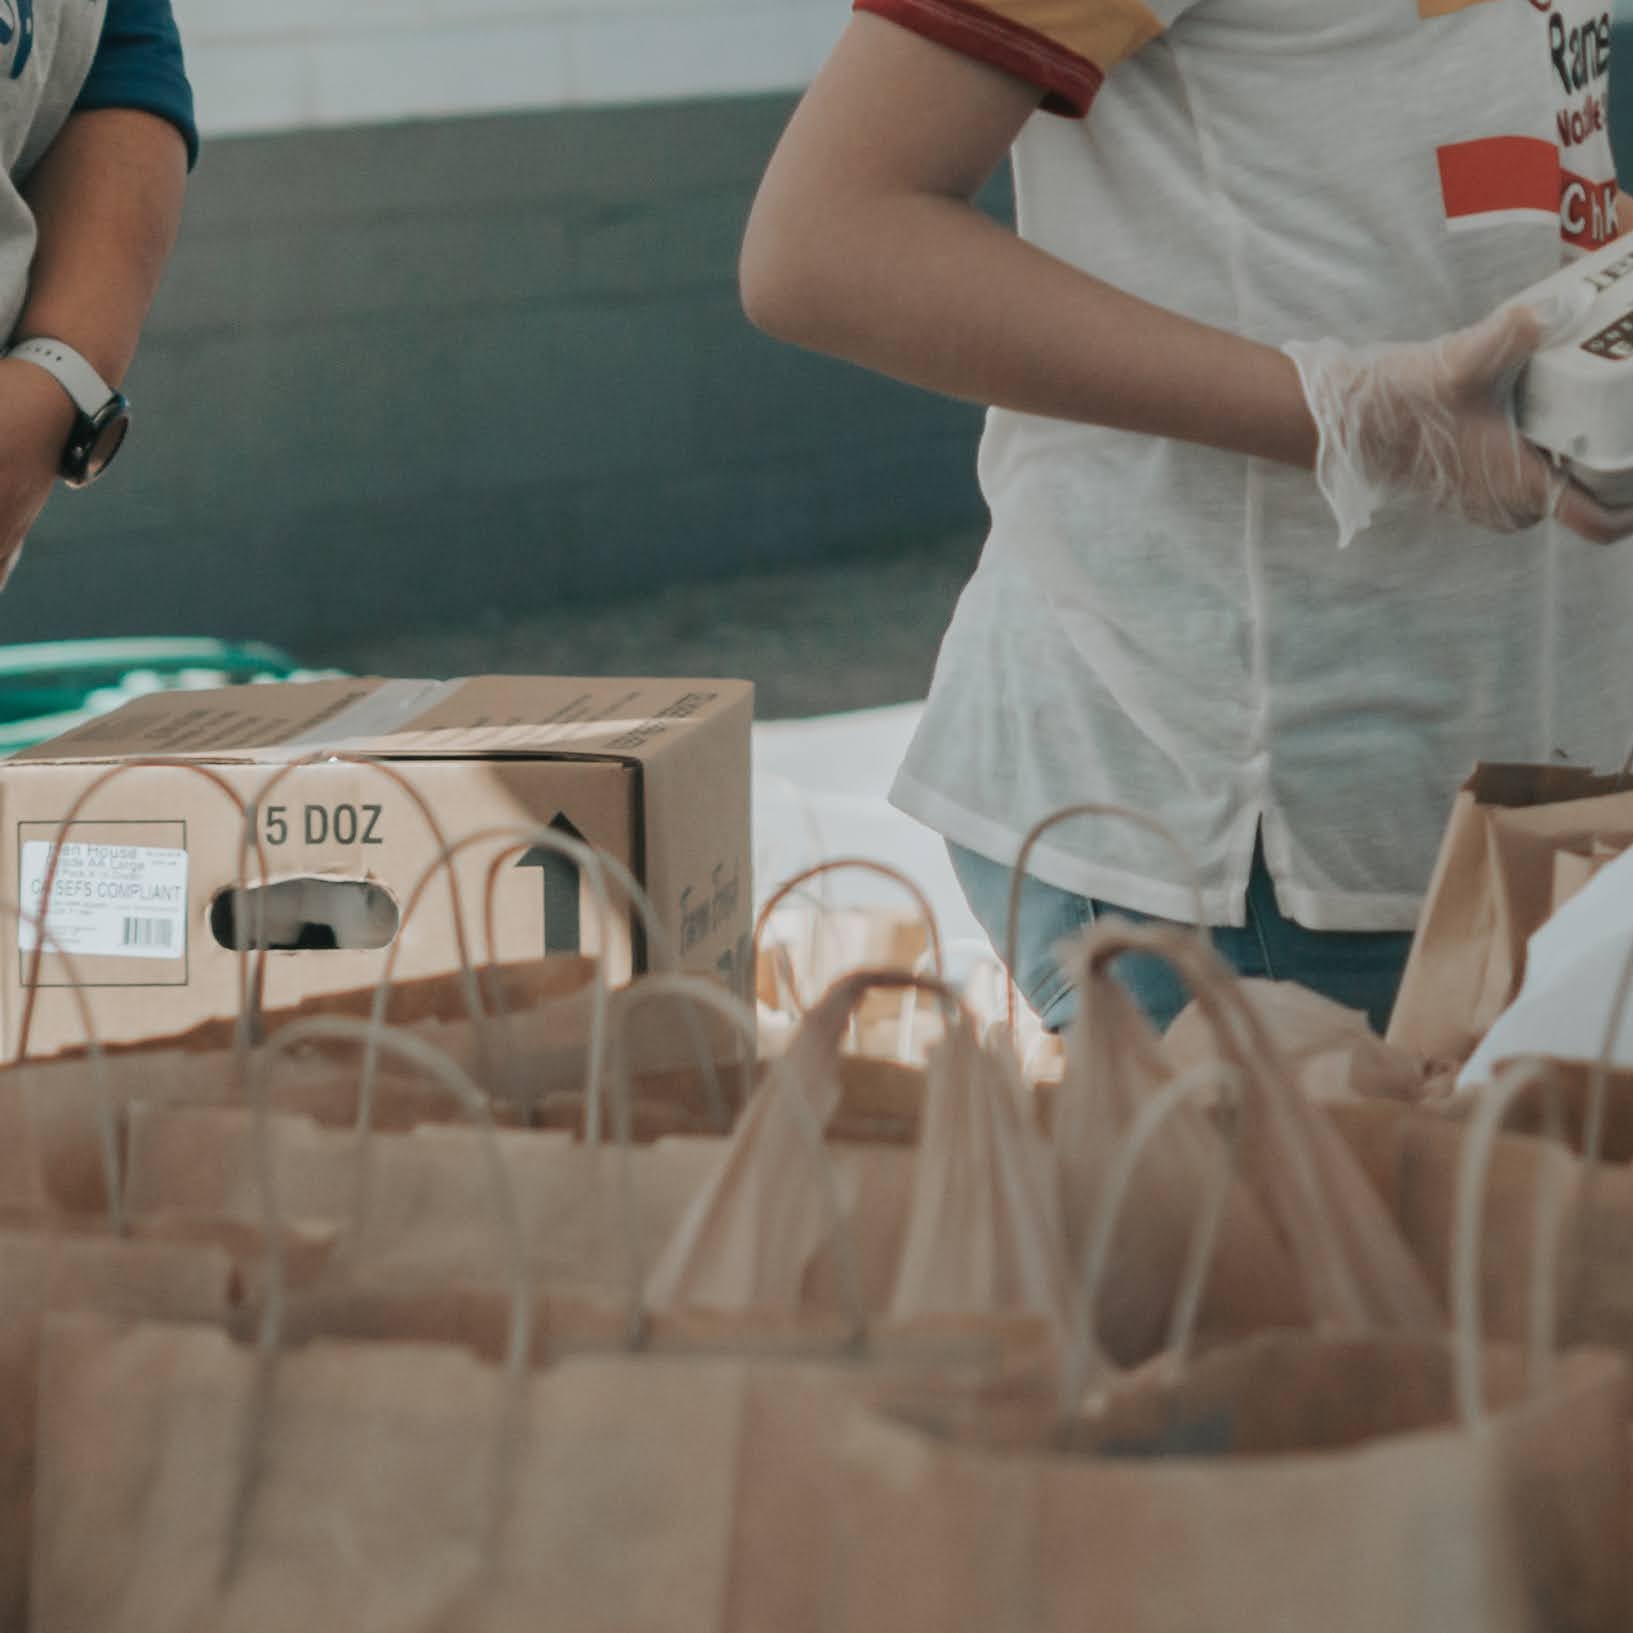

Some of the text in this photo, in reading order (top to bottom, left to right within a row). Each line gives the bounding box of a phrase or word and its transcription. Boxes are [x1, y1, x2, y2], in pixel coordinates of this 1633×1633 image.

[304, 803, 383, 846] DOZ
[88, 845, 137, 859] House
[97, 882, 182, 901] COMPLIANT
